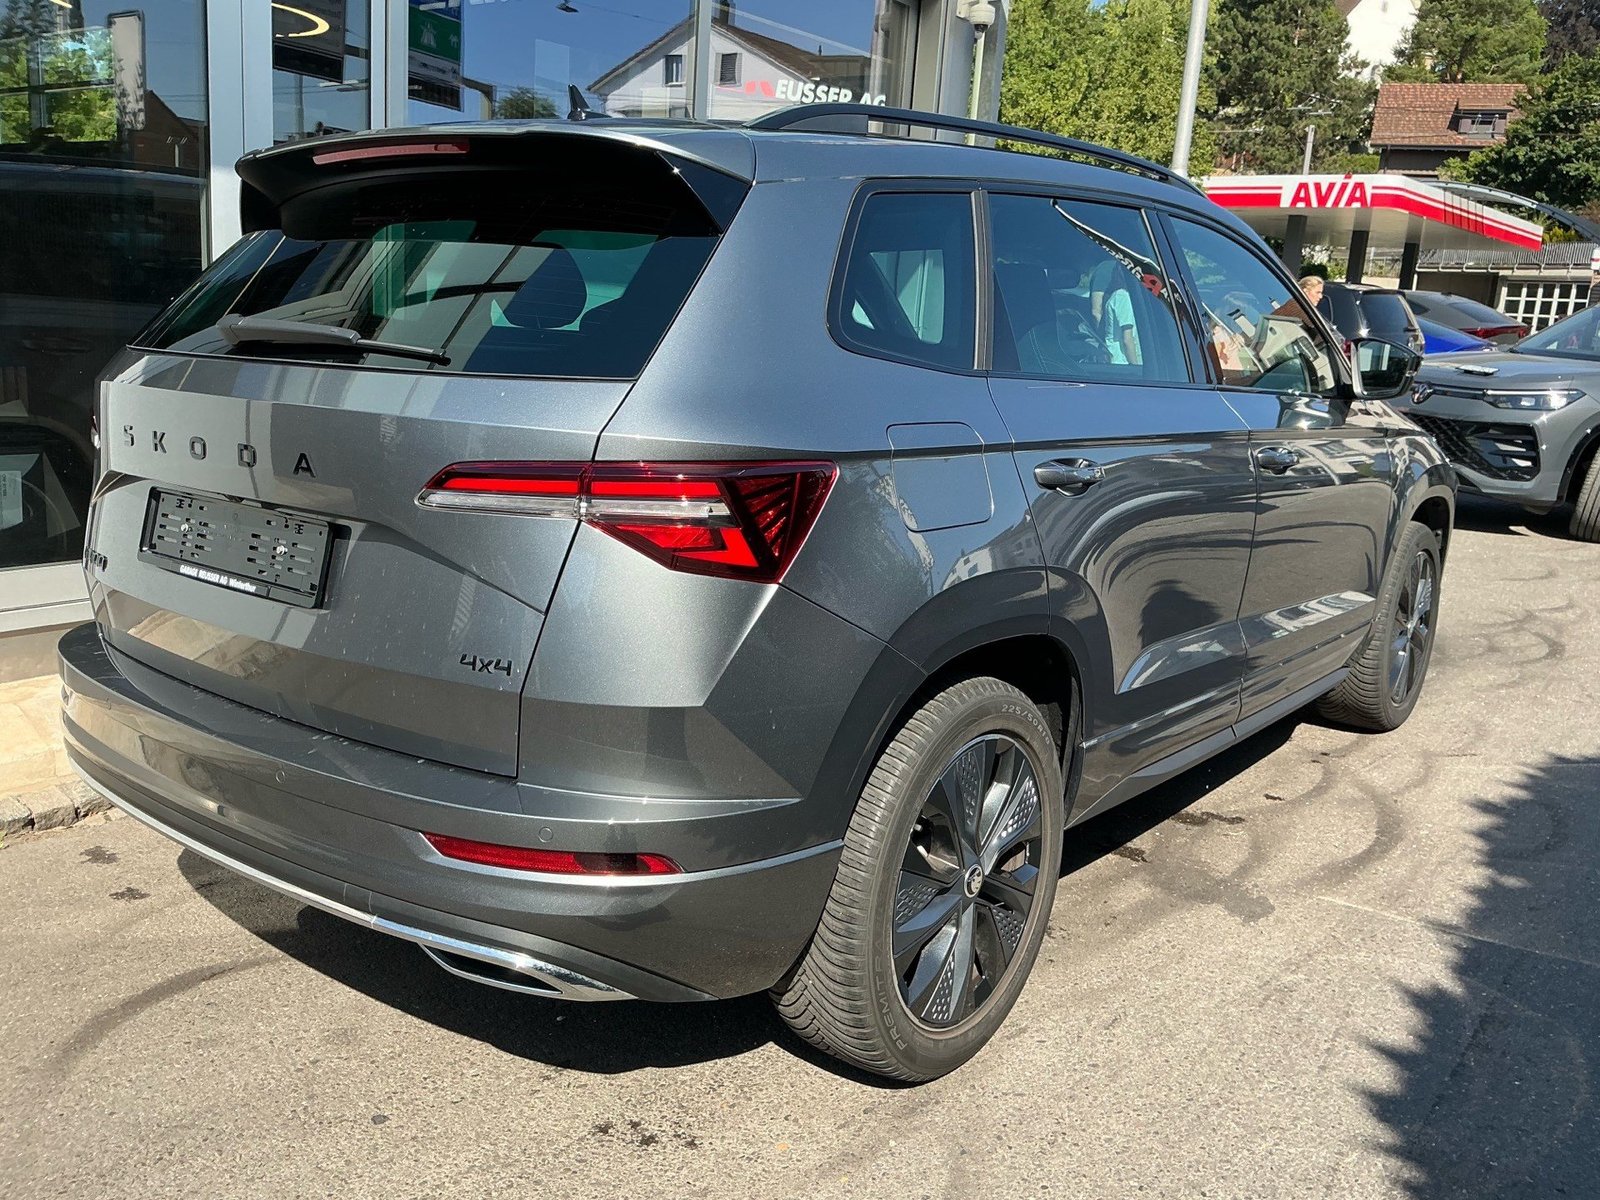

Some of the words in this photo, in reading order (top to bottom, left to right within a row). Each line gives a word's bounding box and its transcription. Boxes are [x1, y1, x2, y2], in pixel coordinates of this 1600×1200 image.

[1289, 171, 1369, 208] AVIA
[180, 564, 199, 578] GARAGE
[198, 569, 220, 584] REUSSER
[219, 575, 229, 586] AG
[228, 577, 257, 593] Winterthur
[459, 653, 513, 677] 4x4
